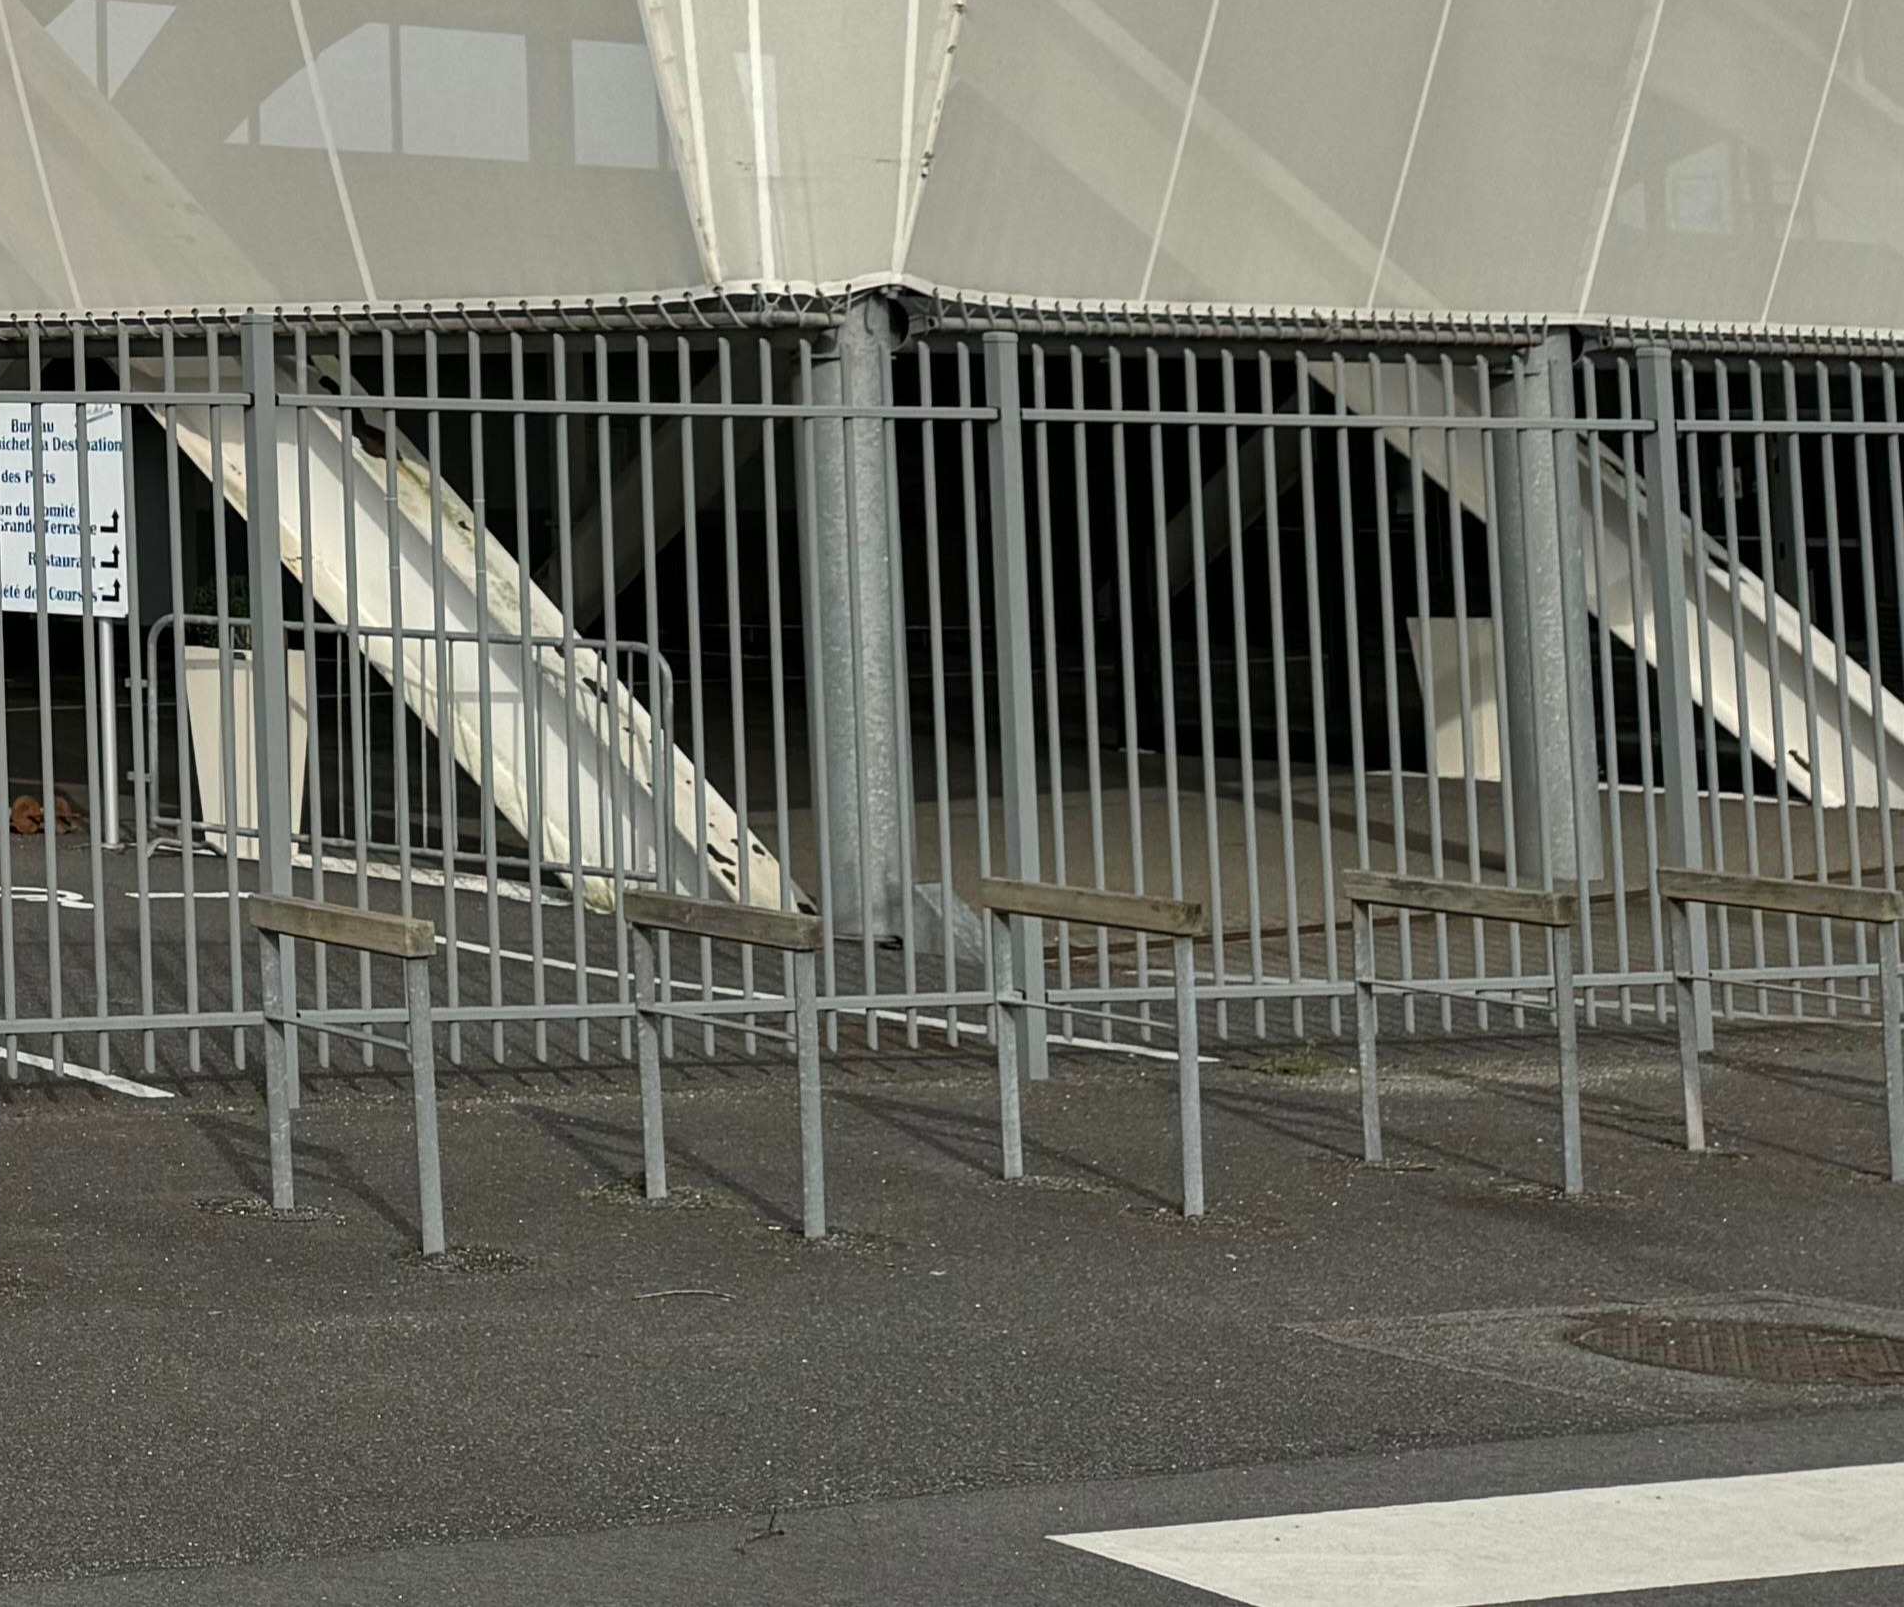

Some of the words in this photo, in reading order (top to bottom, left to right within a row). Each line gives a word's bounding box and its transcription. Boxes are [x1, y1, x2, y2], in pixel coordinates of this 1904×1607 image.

[1, 469, 21, 483] des
[15, 502, 30, 516] du
[40, 503, 76, 518] omité
